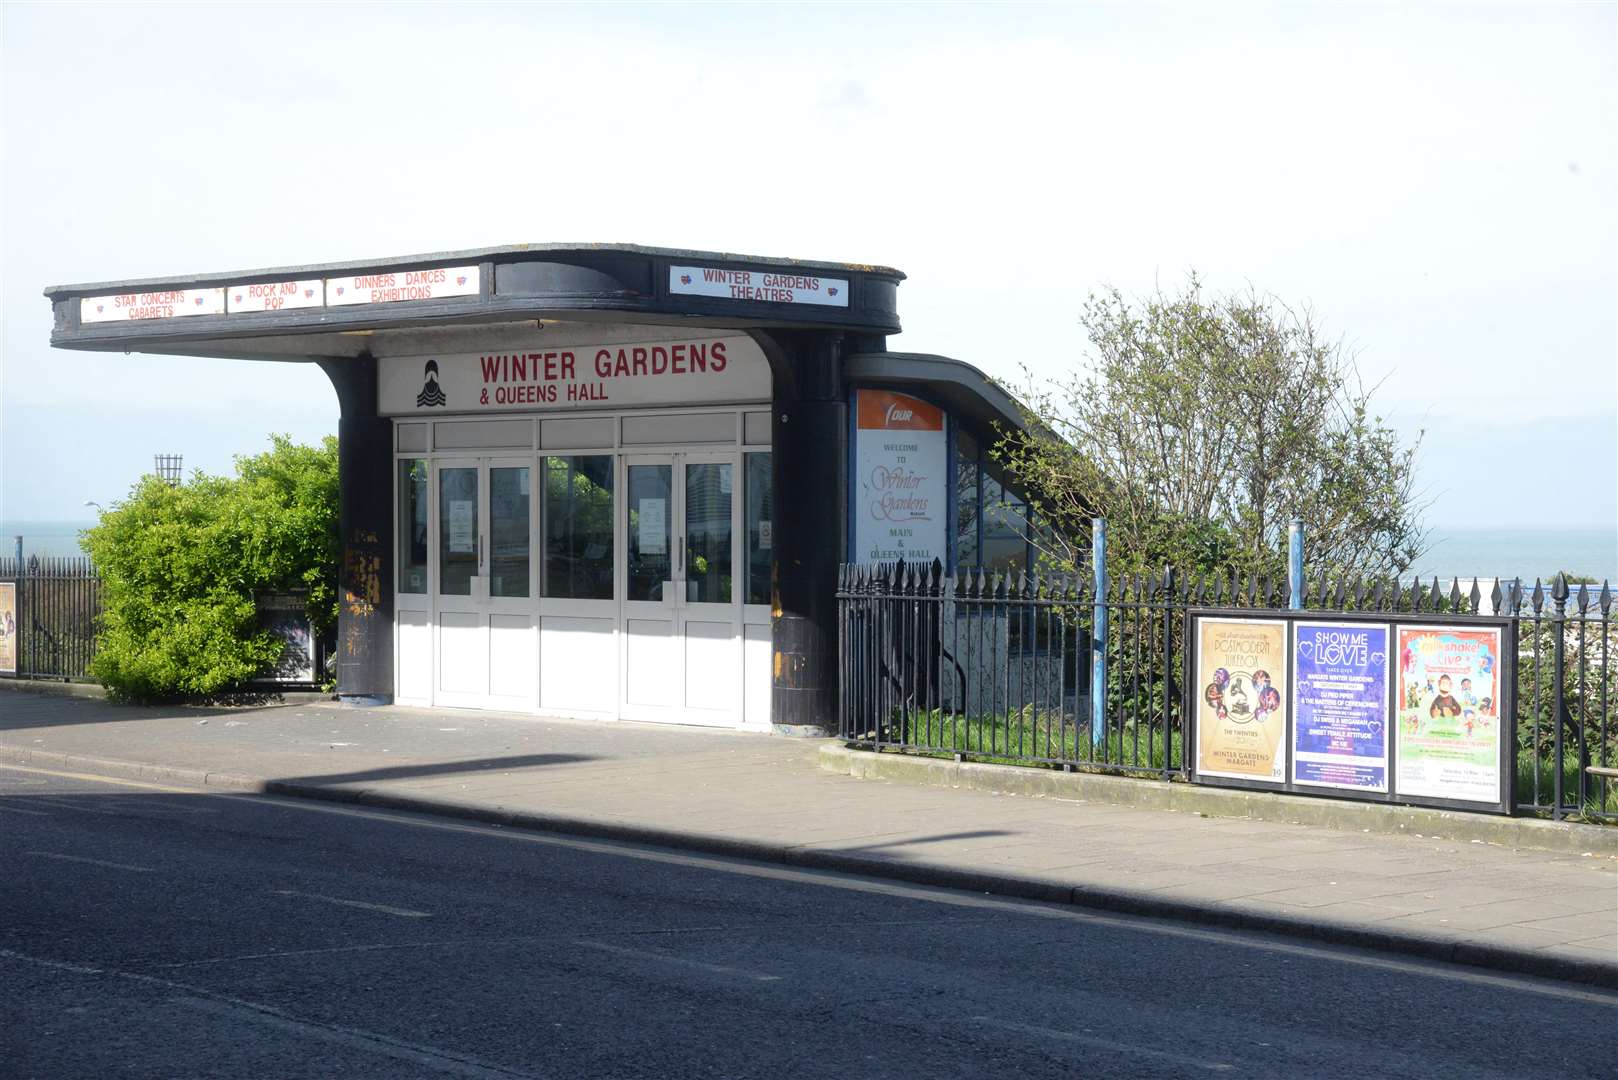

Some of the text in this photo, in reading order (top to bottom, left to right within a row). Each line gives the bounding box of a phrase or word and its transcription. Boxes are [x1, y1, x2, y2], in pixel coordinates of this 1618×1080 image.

[354, 270, 446, 289] DINNERS DANCES
[703, 269, 819, 290] WINTER GARDENS
[249, 282, 297, 297] ROCK AND
[371, 286, 432, 303] EXHIBITIONS
[729, 285, 793, 302] THEATRES
[114, 291, 184, 308] STAR CONCERTS
[265, 297, 284, 310] POP
[129, 306, 174, 320] CABARETS
[480, 342, 727, 383] WINTER GARDENS
[480, 383, 608, 404] & QUEENS HALL
[884, 444, 918, 452] WELCOME
[896, 456, 906, 464] TO
[871, 491, 930, 521] Gardens
[889, 528, 913, 536] MAIN
[898, 539, 904, 547] &
[909, 550, 931, 558] HALL
[1316, 632, 1368, 646] SHOW ME
[1215, 639, 1270, 655] POSTMODERN
[1225, 654, 1259, 668] JUKEBOX
[1315, 643, 1368, 666] LOVE
[1212, 750, 1270, 760] WINTER GARDENS
[1226, 758, 1256, 766] MARGATE
